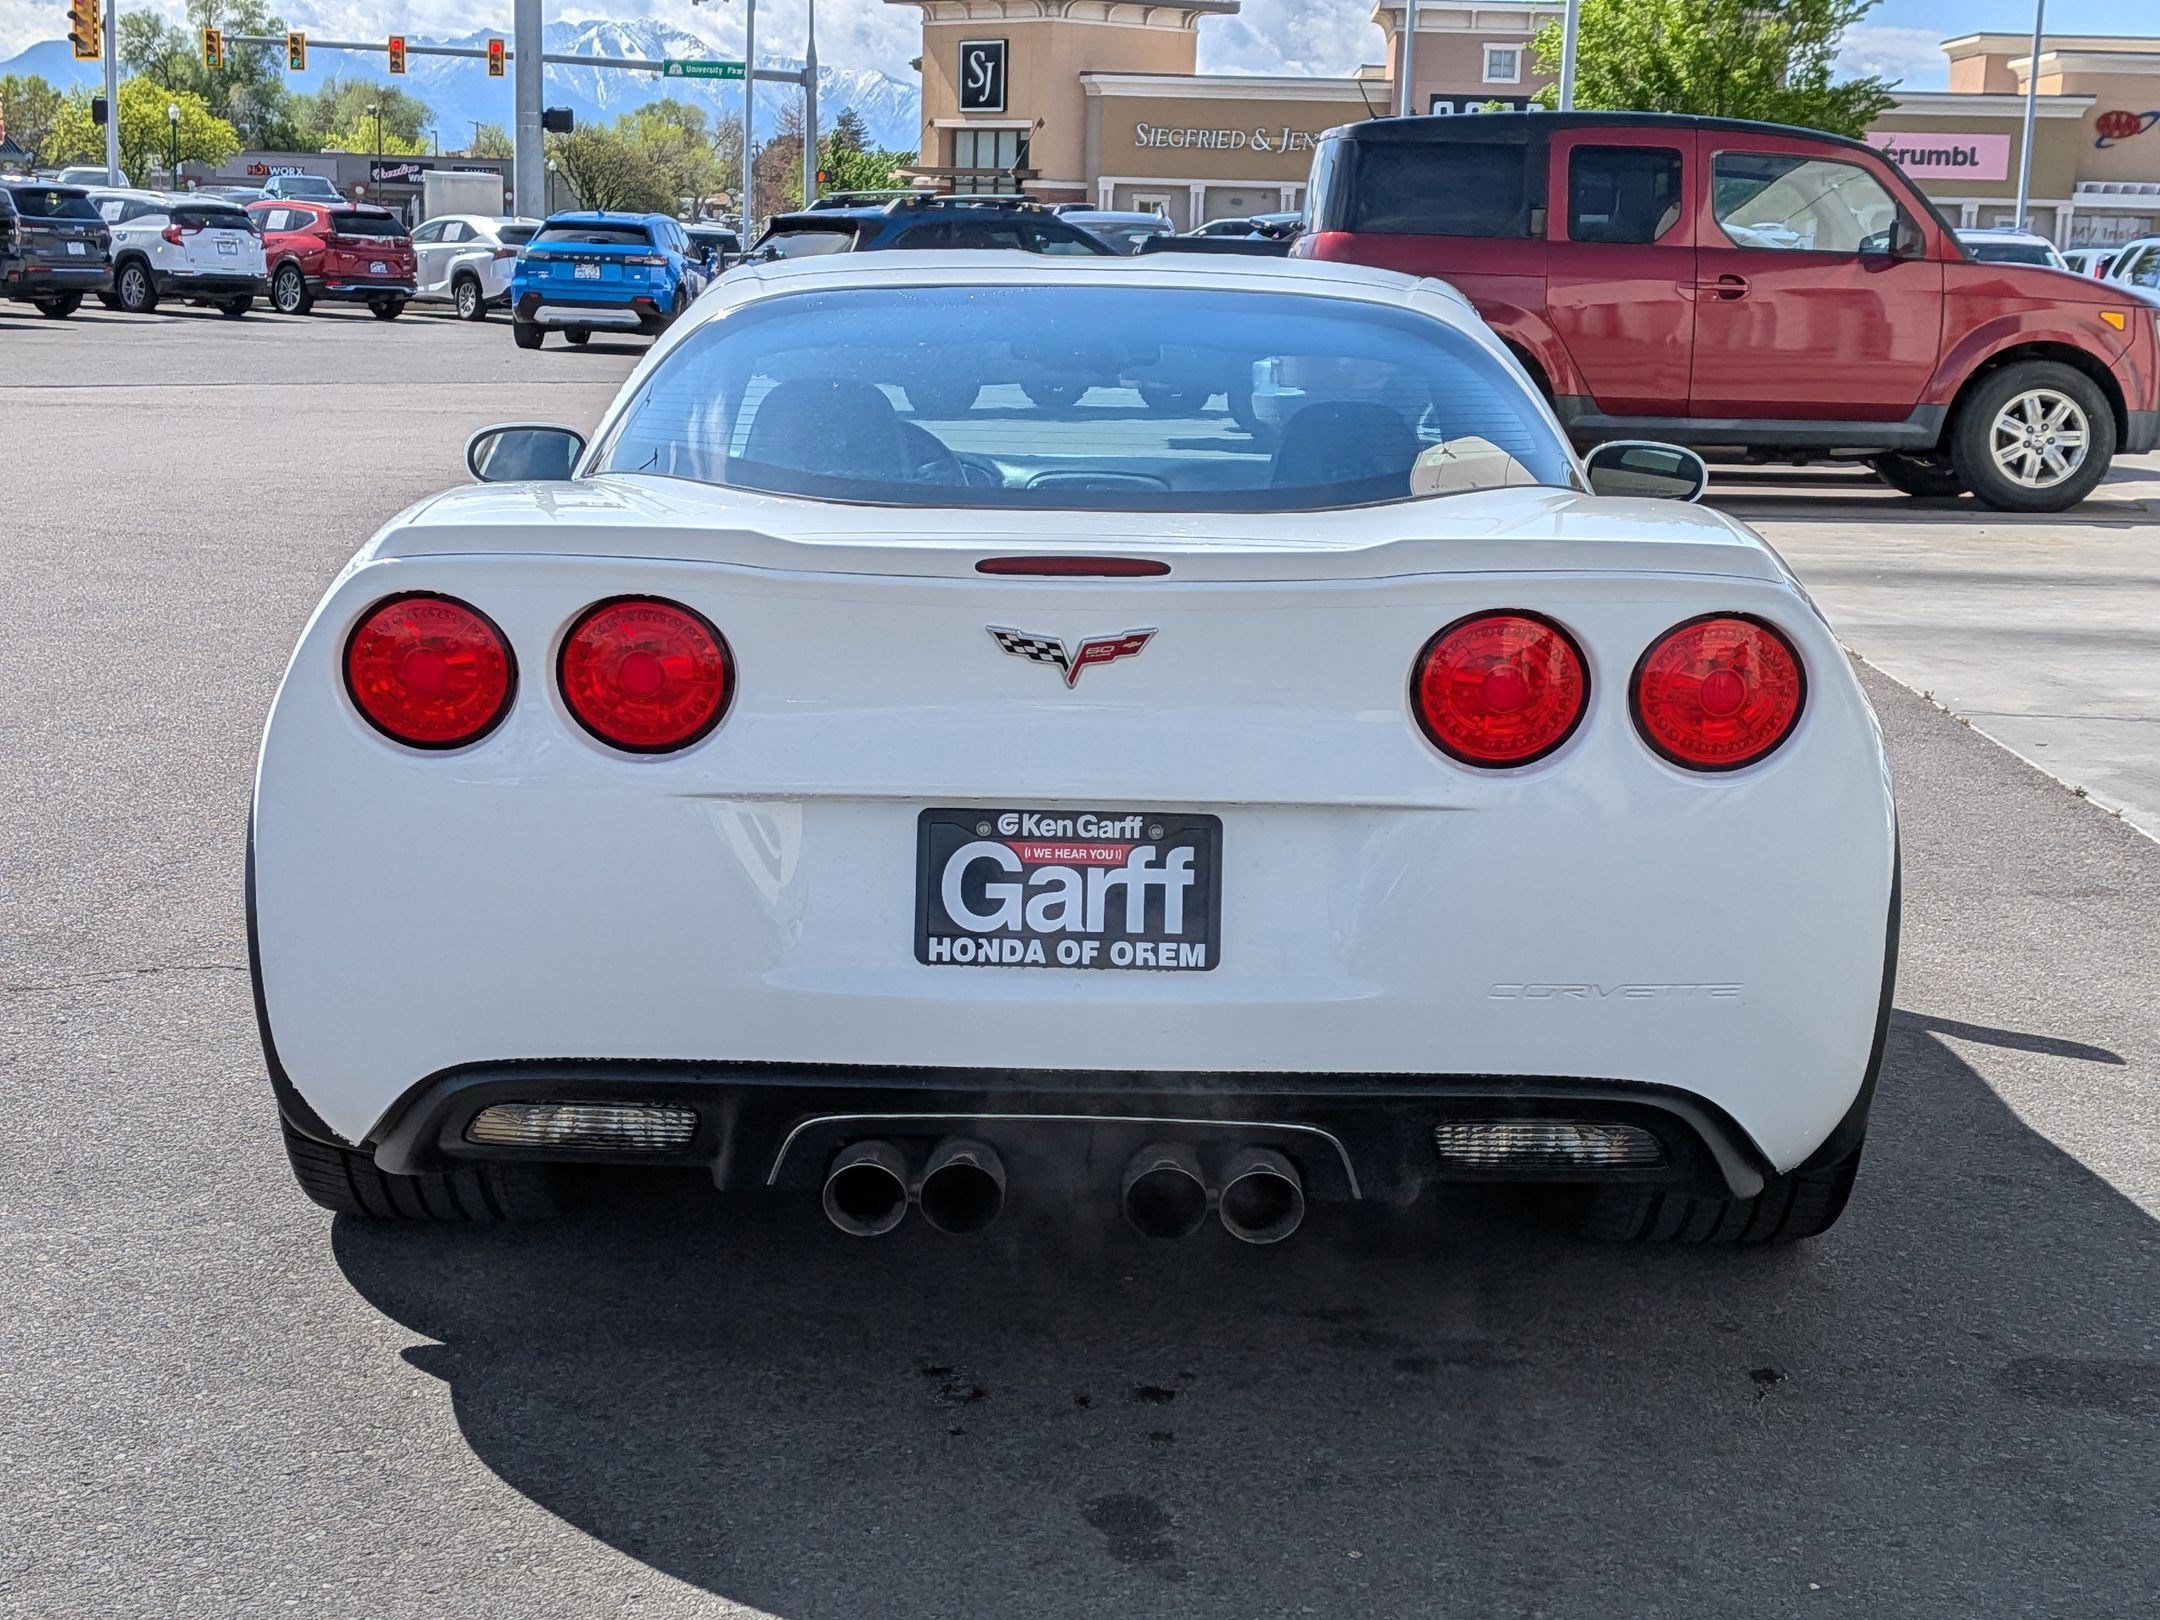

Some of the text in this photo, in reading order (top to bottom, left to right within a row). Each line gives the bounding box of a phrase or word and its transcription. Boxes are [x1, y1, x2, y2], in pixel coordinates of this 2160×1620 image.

[686, 64, 723, 76] University
[967, 50, 996, 103] SJ
[1135, 123, 1246, 150] SIEGFRIED
[1251, 128, 1273, 151] &
[1888, 146, 1979, 166] crumbl
[247, 163, 304, 176] HOTWORX
[1022, 814, 1143, 839] Ken Garff
[1033, 848, 1114, 860] WE HEAR YOU
[941, 841, 1195, 934] Garff
[928, 937, 1206, 967] HONDA OF OREM
